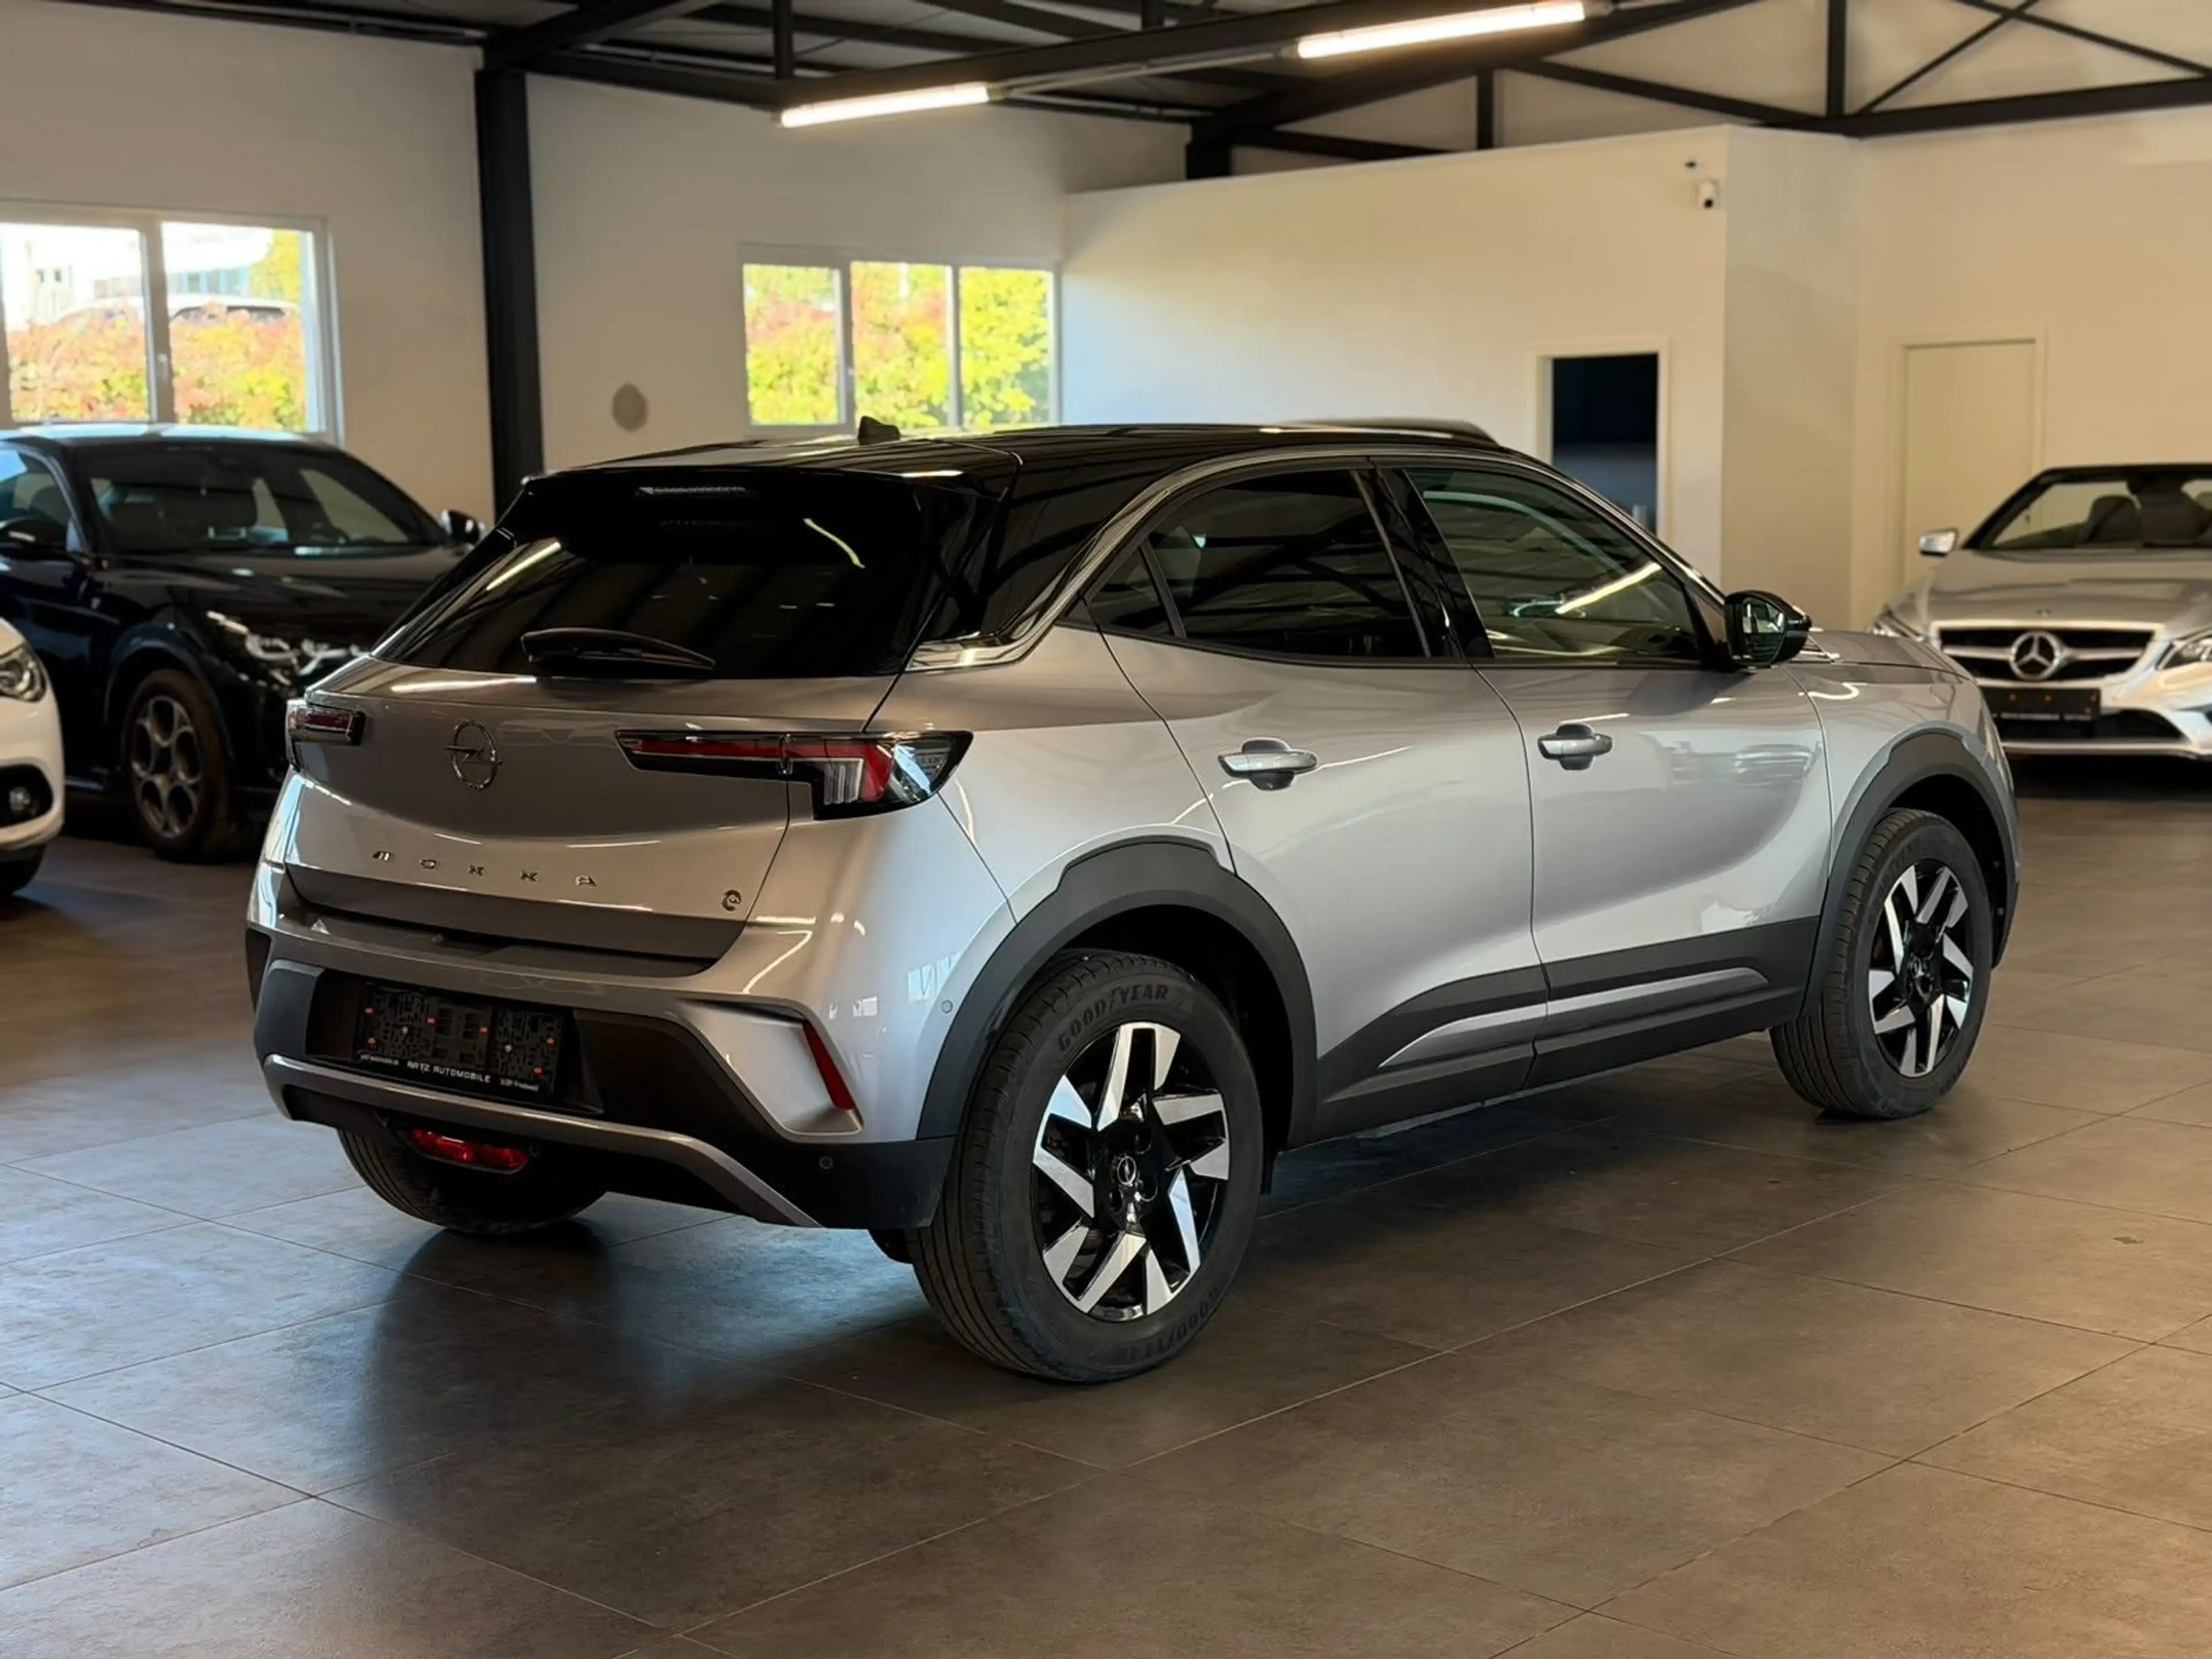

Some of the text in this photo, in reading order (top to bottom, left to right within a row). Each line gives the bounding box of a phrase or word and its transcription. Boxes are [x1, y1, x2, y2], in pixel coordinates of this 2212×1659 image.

[372, 850, 597, 887] MOKKA
[1059, 984, 1169, 1053] GOODYEAR
[433, 1065, 491, 1084] AUTOMOBILE
